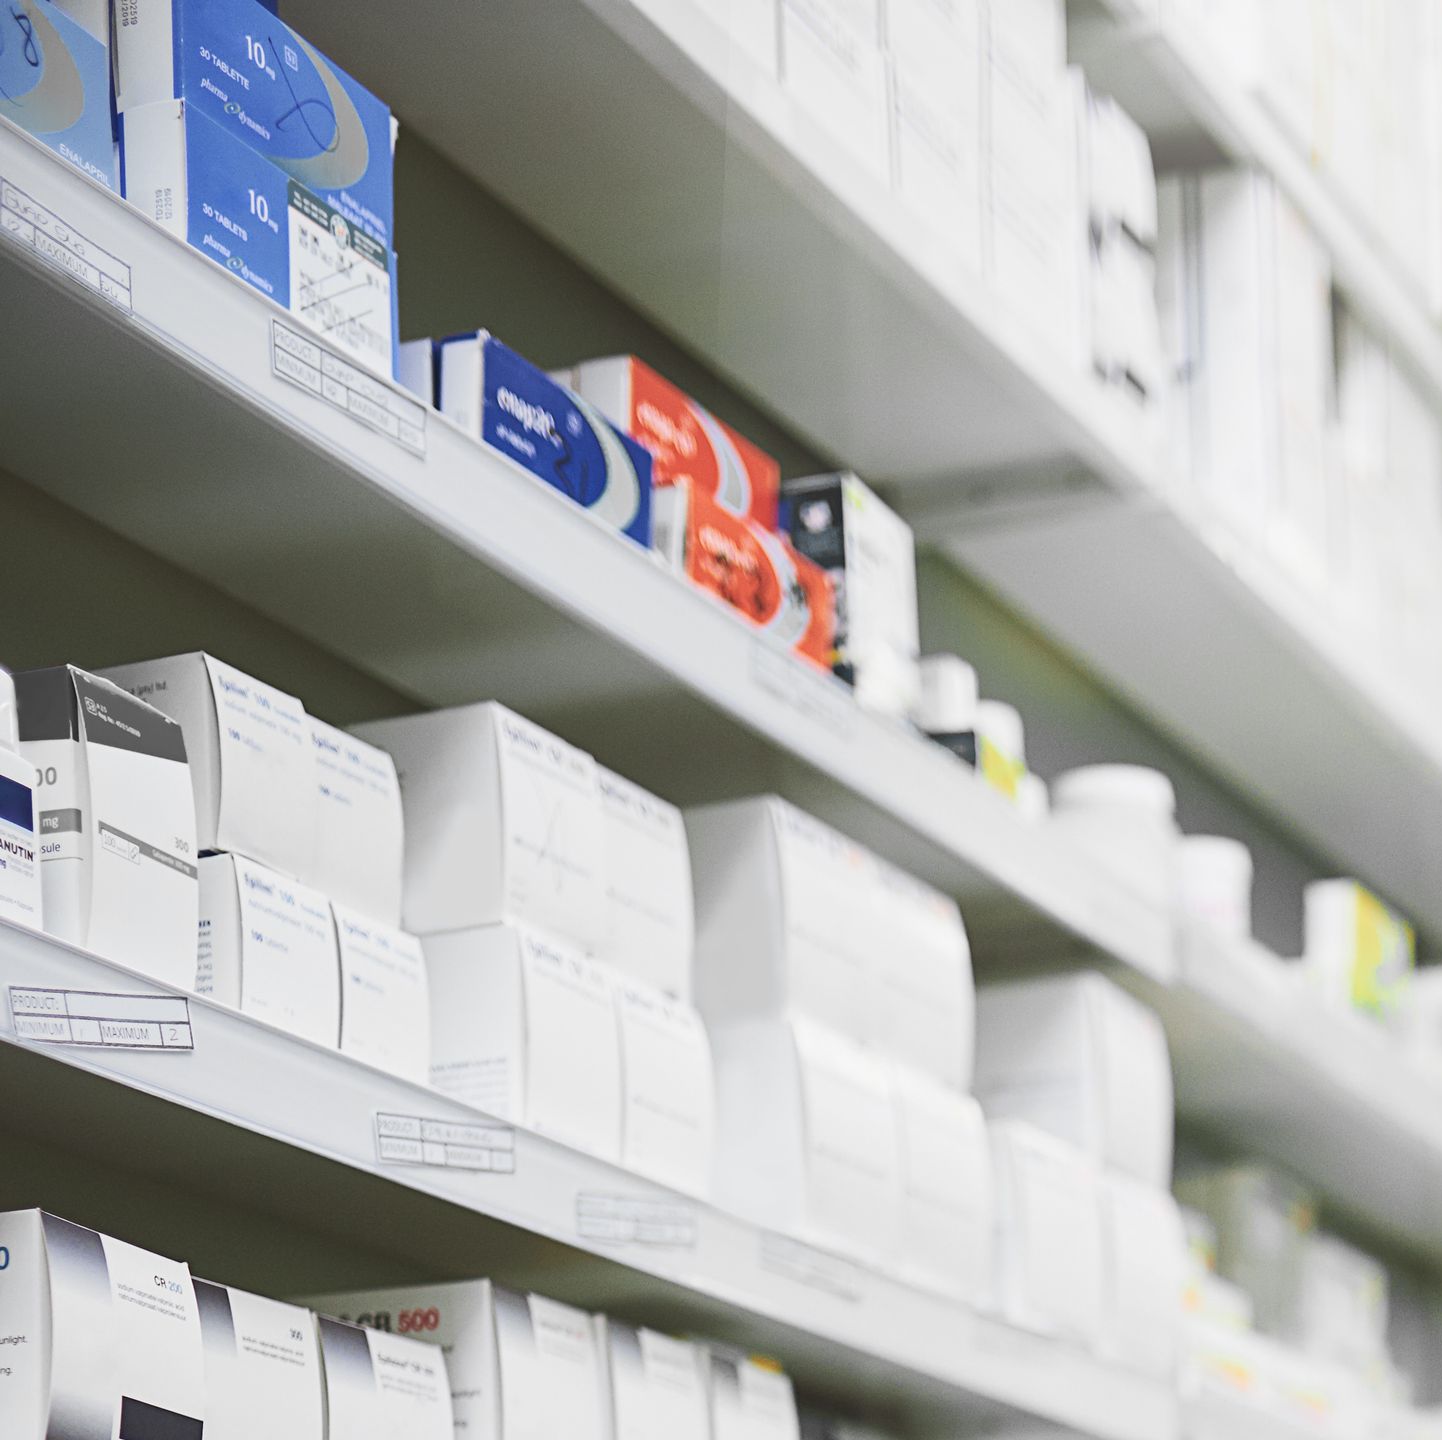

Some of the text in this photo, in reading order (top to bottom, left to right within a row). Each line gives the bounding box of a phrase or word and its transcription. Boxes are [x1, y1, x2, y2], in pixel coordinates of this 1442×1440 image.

[245, 35, 265, 69] 10
[200, 47, 250, 90] 30 TABLETTE
[201, 77, 228, 102] pharma
[58, 143, 112, 187] ENALAPRIL
[247, 189, 268, 222] 10
[202, 203, 248, 241] 30 TABLETS
[36, 235, 89, 279] MAXIMUM
[202, 232, 231, 257] pharma
[42, 816, 59, 829] mg
[41, 842, 61, 854] sule
[13, 994, 59, 1010] PRODUCT:
[16, 1020, 178, 1041] MINIMUM MAXIMUM 2
[154, 1275, 183, 1295] CR 200
[398, 1306, 440, 1333] 500
